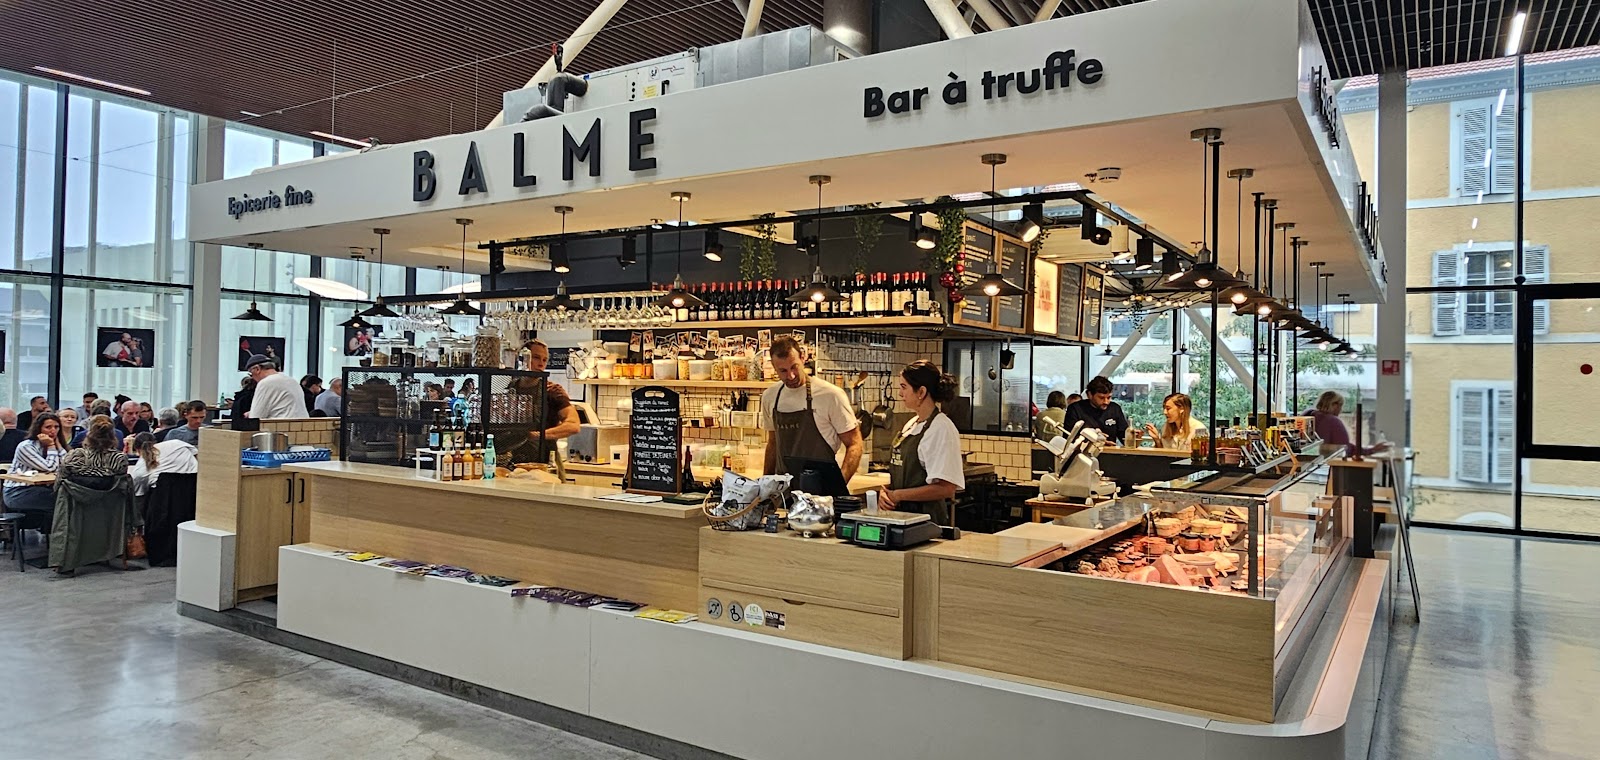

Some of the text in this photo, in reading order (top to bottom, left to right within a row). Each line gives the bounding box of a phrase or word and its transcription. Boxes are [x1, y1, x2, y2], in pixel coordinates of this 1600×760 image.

[863, 49, 1104, 119] Bar à truffe
[412, 107, 660, 202] BALME
[228, 184, 314, 220] Epicerie fine
